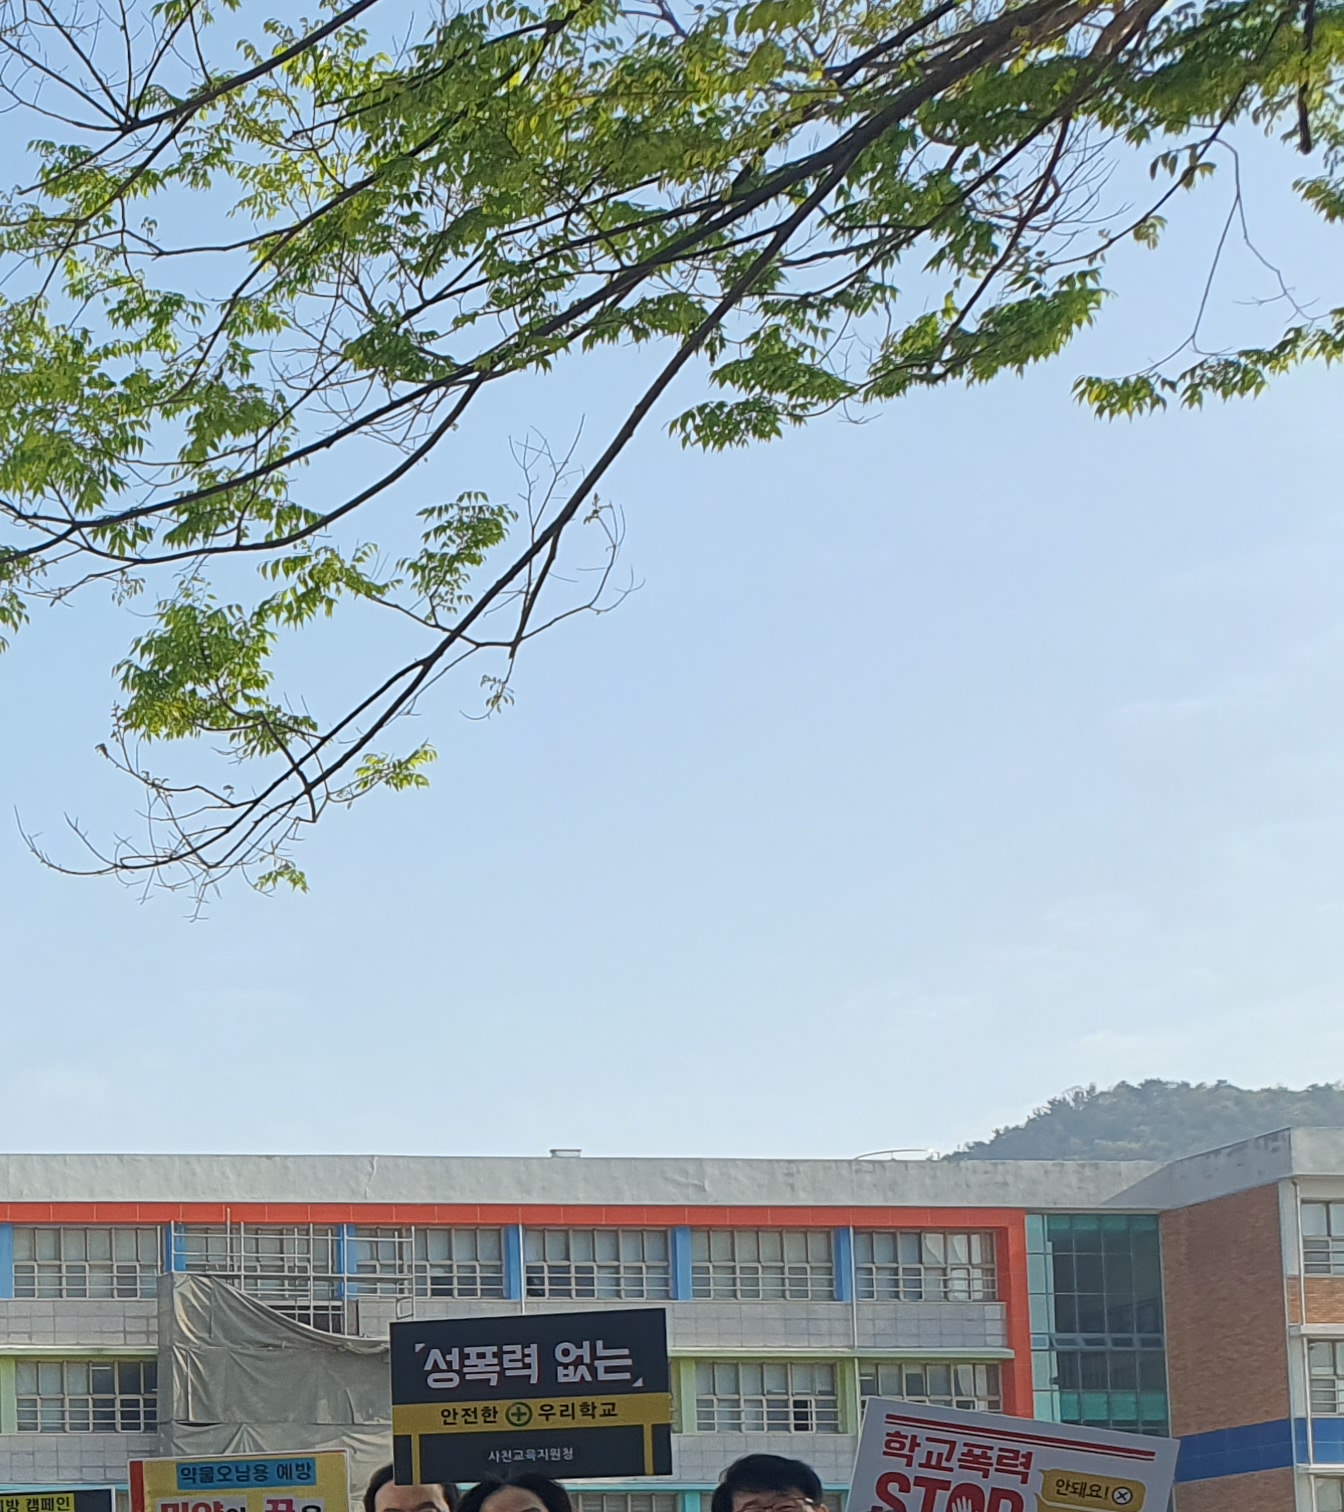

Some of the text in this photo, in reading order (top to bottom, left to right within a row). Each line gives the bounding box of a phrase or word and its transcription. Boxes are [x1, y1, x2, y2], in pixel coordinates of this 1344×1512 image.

[554, 1339, 633, 1384] 없는
[440, 1401, 619, 1426] 안전한 우리학교
[488, 1447, 574, 1464] 사천교육지원청
[882, 1430, 1033, 1485] 학교폭력
[179, 1461, 313, 1485] 약물오남용 예방
[26, 1496, 71, 1512] 캠페인
